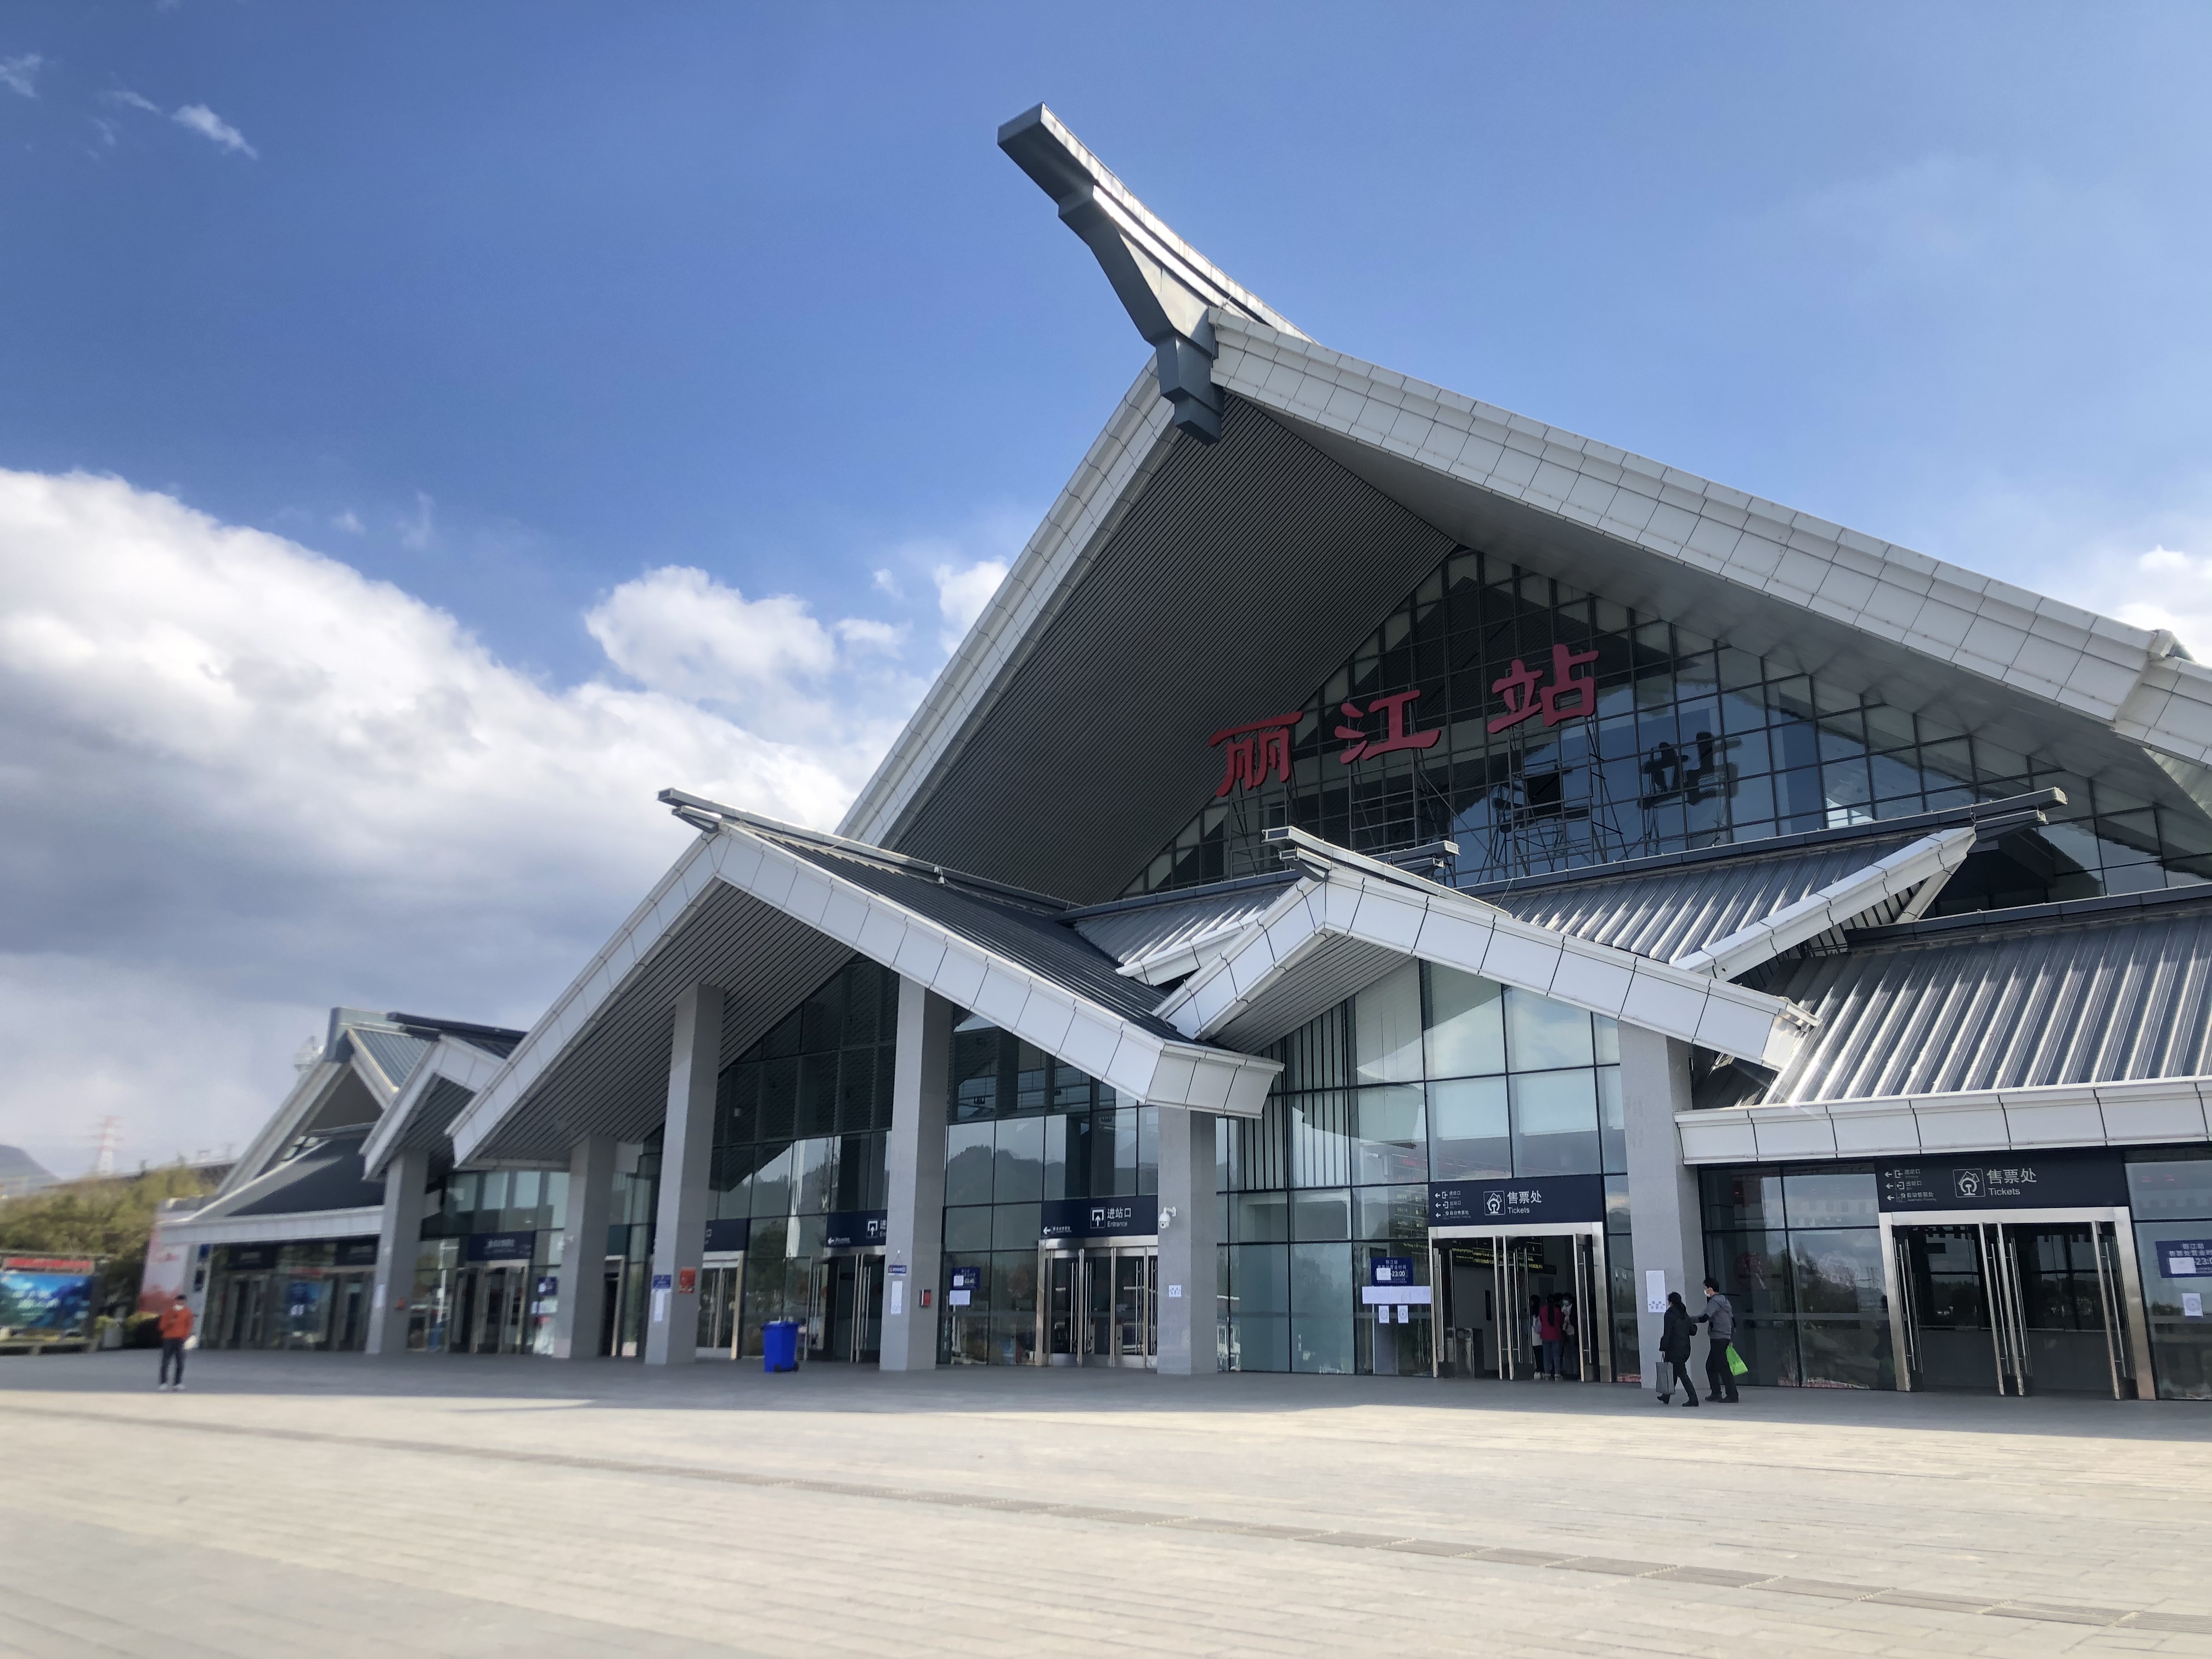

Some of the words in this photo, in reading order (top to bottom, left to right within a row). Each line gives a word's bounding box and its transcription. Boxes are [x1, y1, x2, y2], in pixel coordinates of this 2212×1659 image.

[1208, 643, 1599, 797] 丽江站
[1987, 1168, 2037, 1184] 售票处
[1507, 1190, 1542, 1205] 售票处
[1988, 1188, 2021, 1196] Tickets
[1107, 1207, 1131, 1220] 进站口
